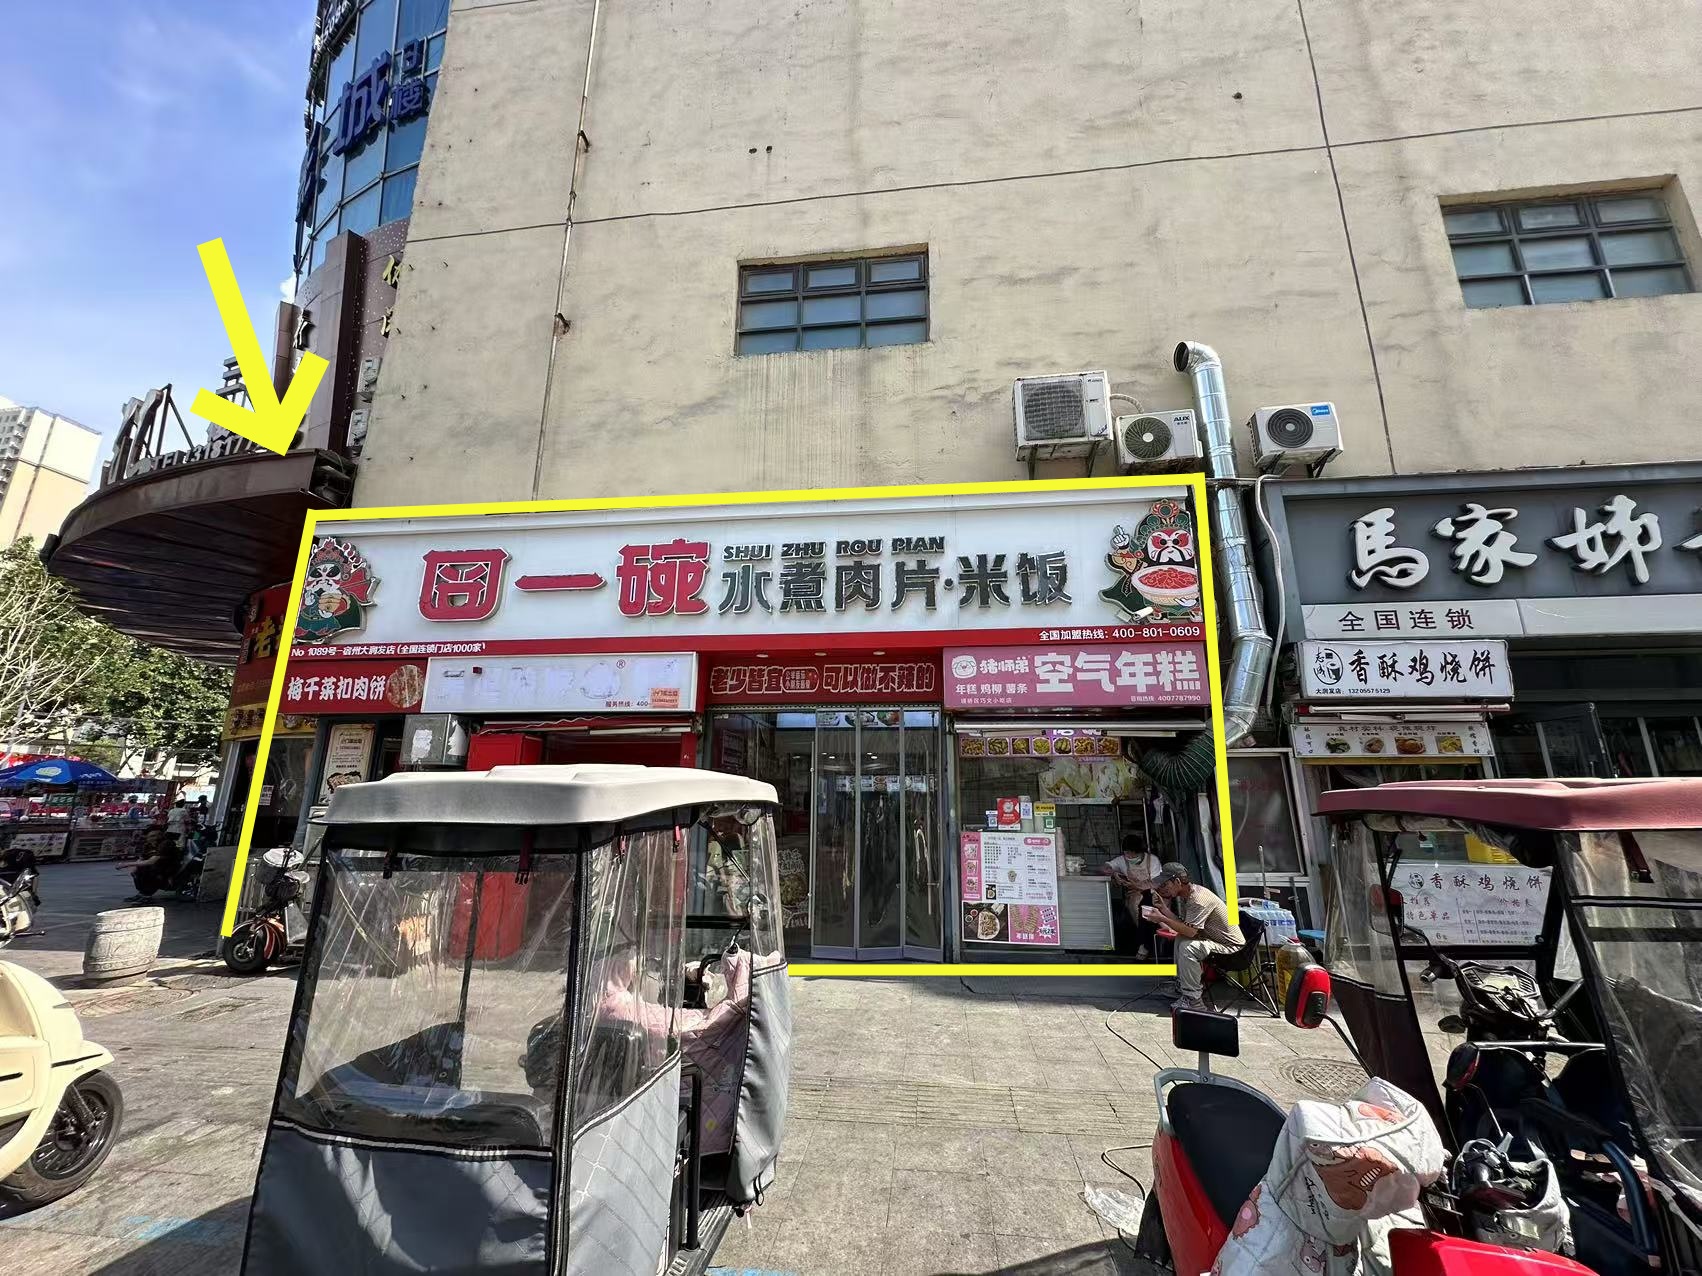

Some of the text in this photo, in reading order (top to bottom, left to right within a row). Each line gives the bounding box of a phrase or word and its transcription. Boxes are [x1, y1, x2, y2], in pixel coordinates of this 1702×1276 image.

[723, 536, 945, 560] SHUI ZHU ROU PIAN
[1346, 494, 1702, 592] 馬家姊
[1112, 626, 1200, 639] 400-801-0609
[1339, 608, 1475, 632] 全国连锁
[710, 666, 784, 694] 老少皆宜
[823, 663, 935, 693] 可以做不辣的
[1034, 650, 1201, 693] 空气年糕
[1348, 648, 1496, 687] 香酥鸡烧饼
[287, 675, 386, 701] 梅干菜扣肉饼
[956, 684, 977, 694] 年糕
[980, 683, 1003, 694] 鸡柳
[1430, 872, 1543, 892] 香酥鸡烧饼
